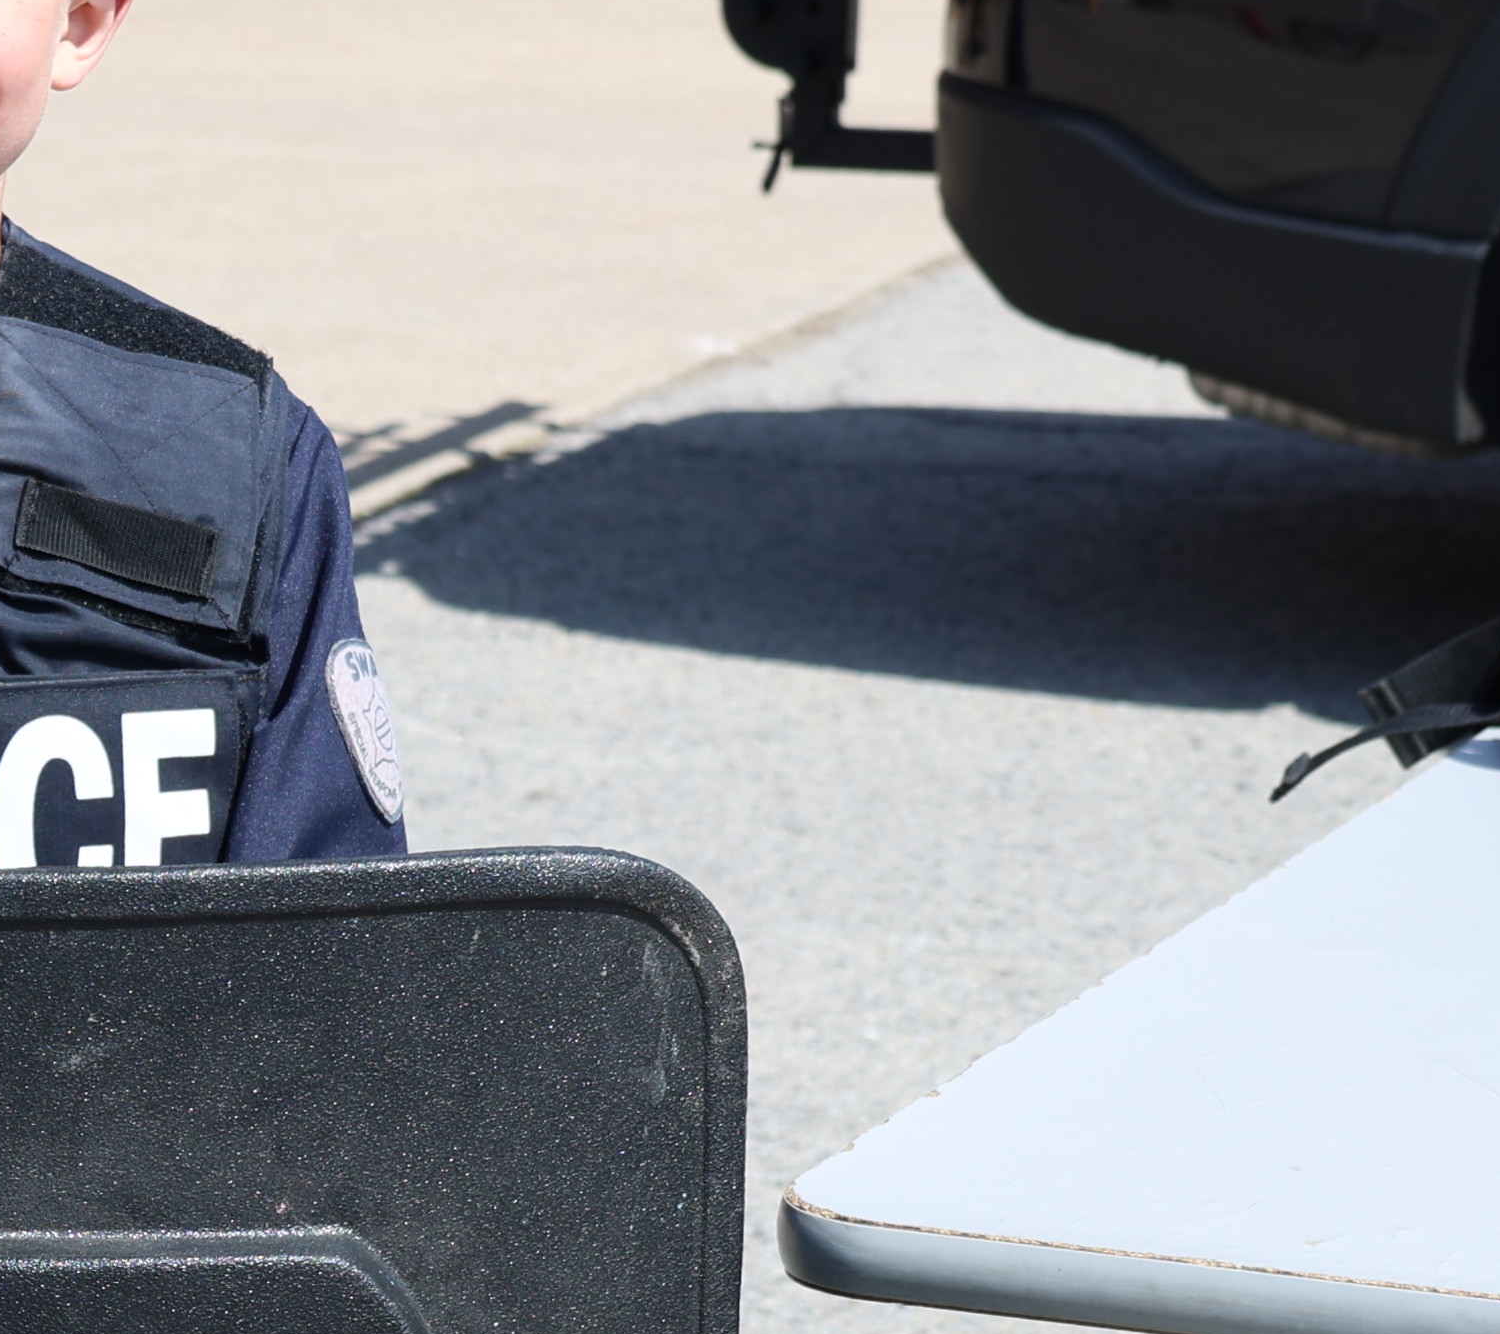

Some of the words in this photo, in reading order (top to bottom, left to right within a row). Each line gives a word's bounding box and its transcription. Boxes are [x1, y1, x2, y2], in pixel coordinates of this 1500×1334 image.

[344, 651, 379, 682] SWA
[347, 712, 371, 763] SPECIAL
[367, 762, 398, 800] WEAPONS
